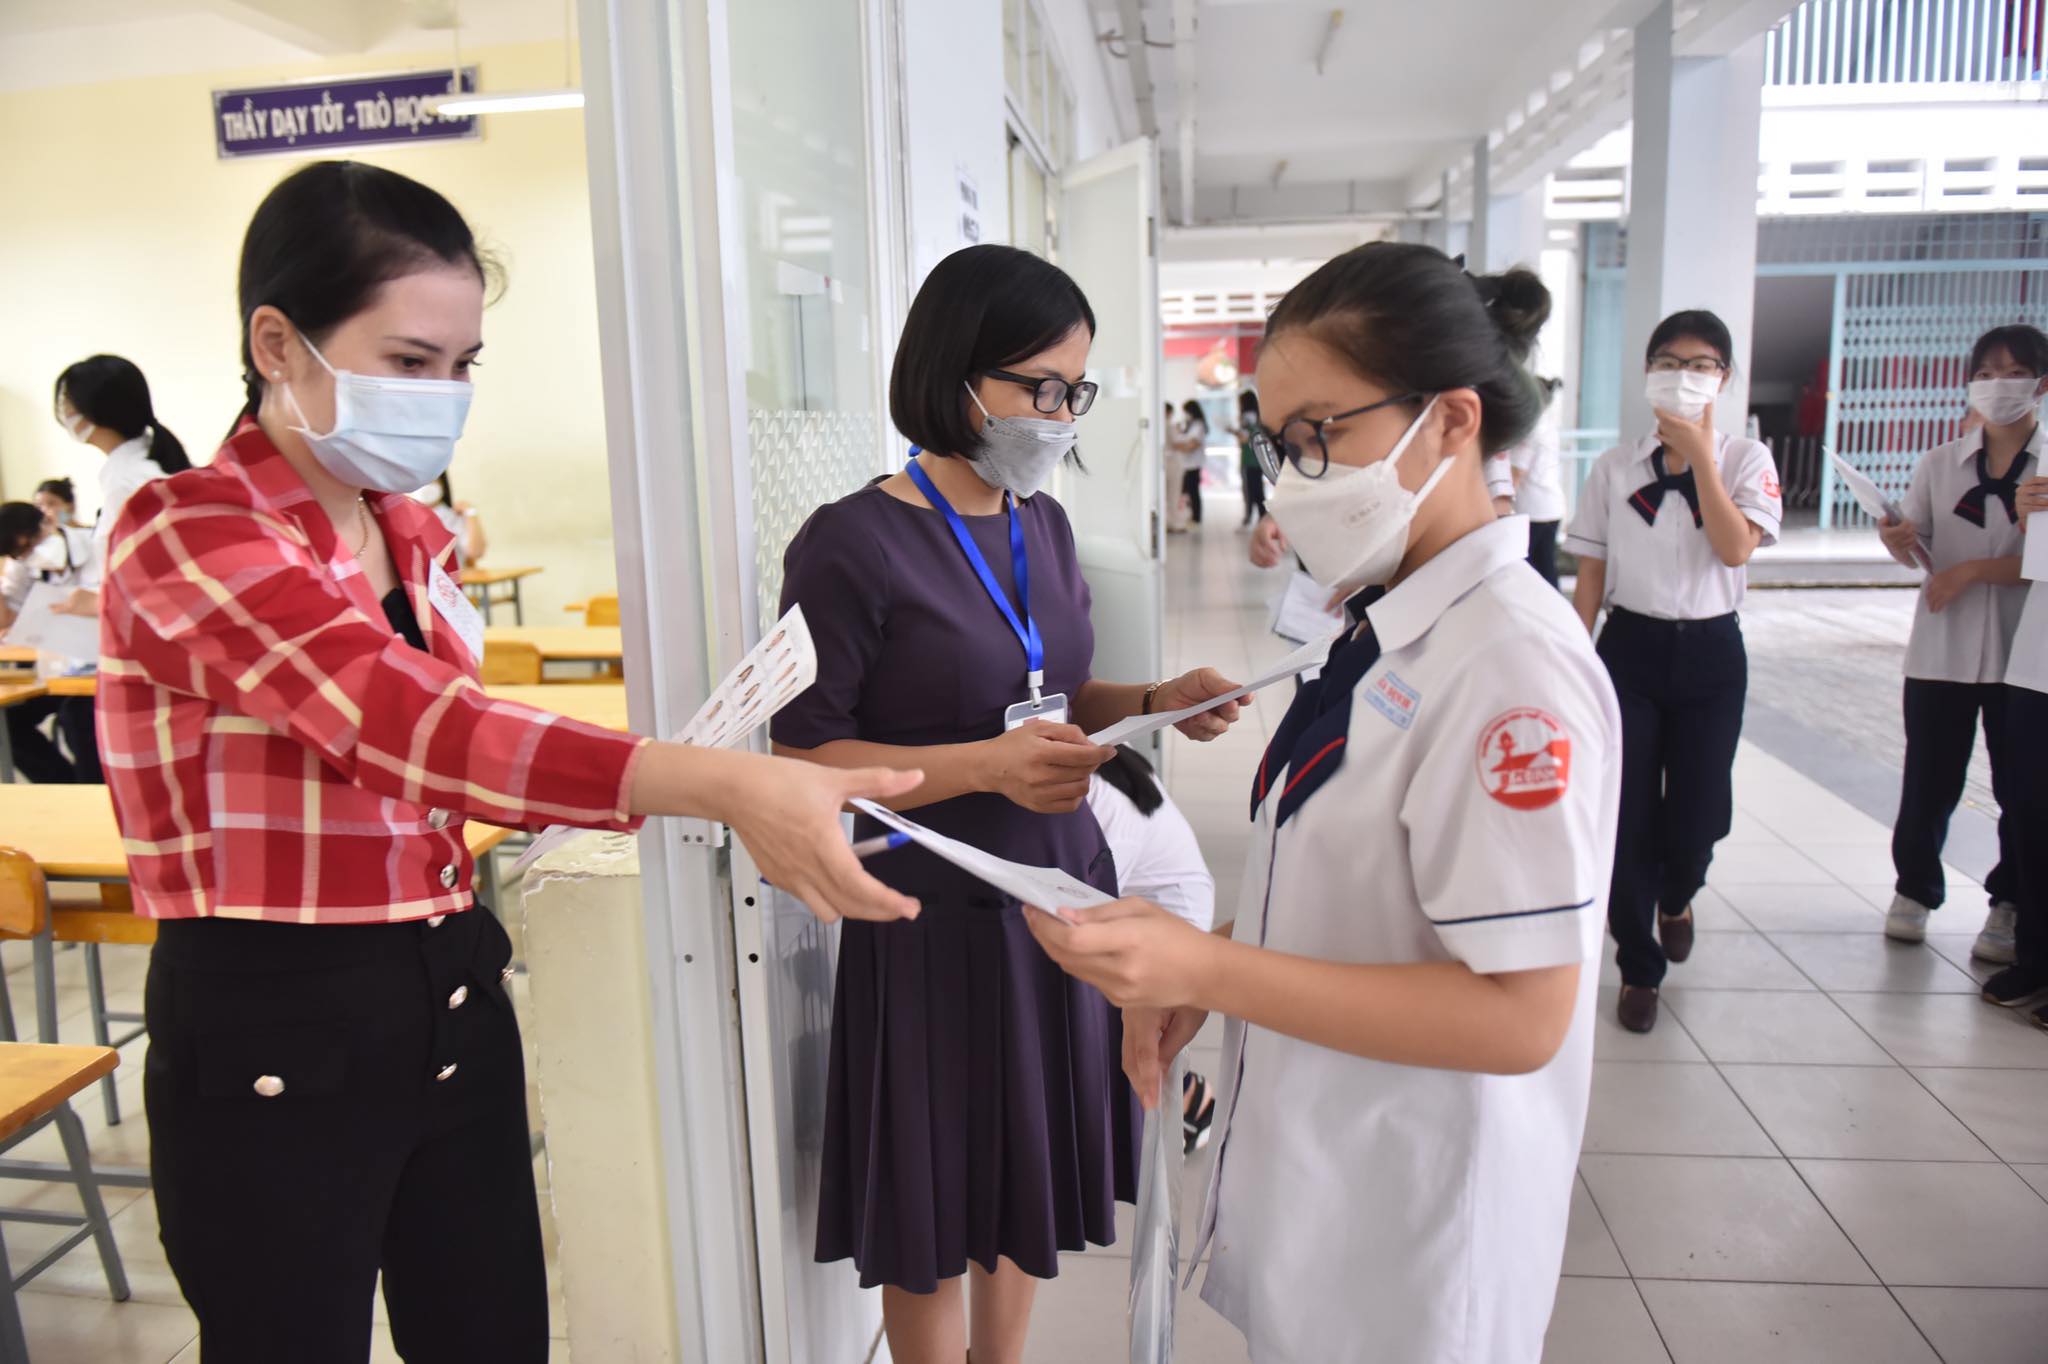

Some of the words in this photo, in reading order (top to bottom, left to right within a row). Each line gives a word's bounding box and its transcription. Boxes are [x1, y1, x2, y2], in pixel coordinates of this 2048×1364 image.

[271, 106, 308, 144] DẠY
[355, 91, 392, 130] TRÒ
[394, 95, 435, 134] HỌC
